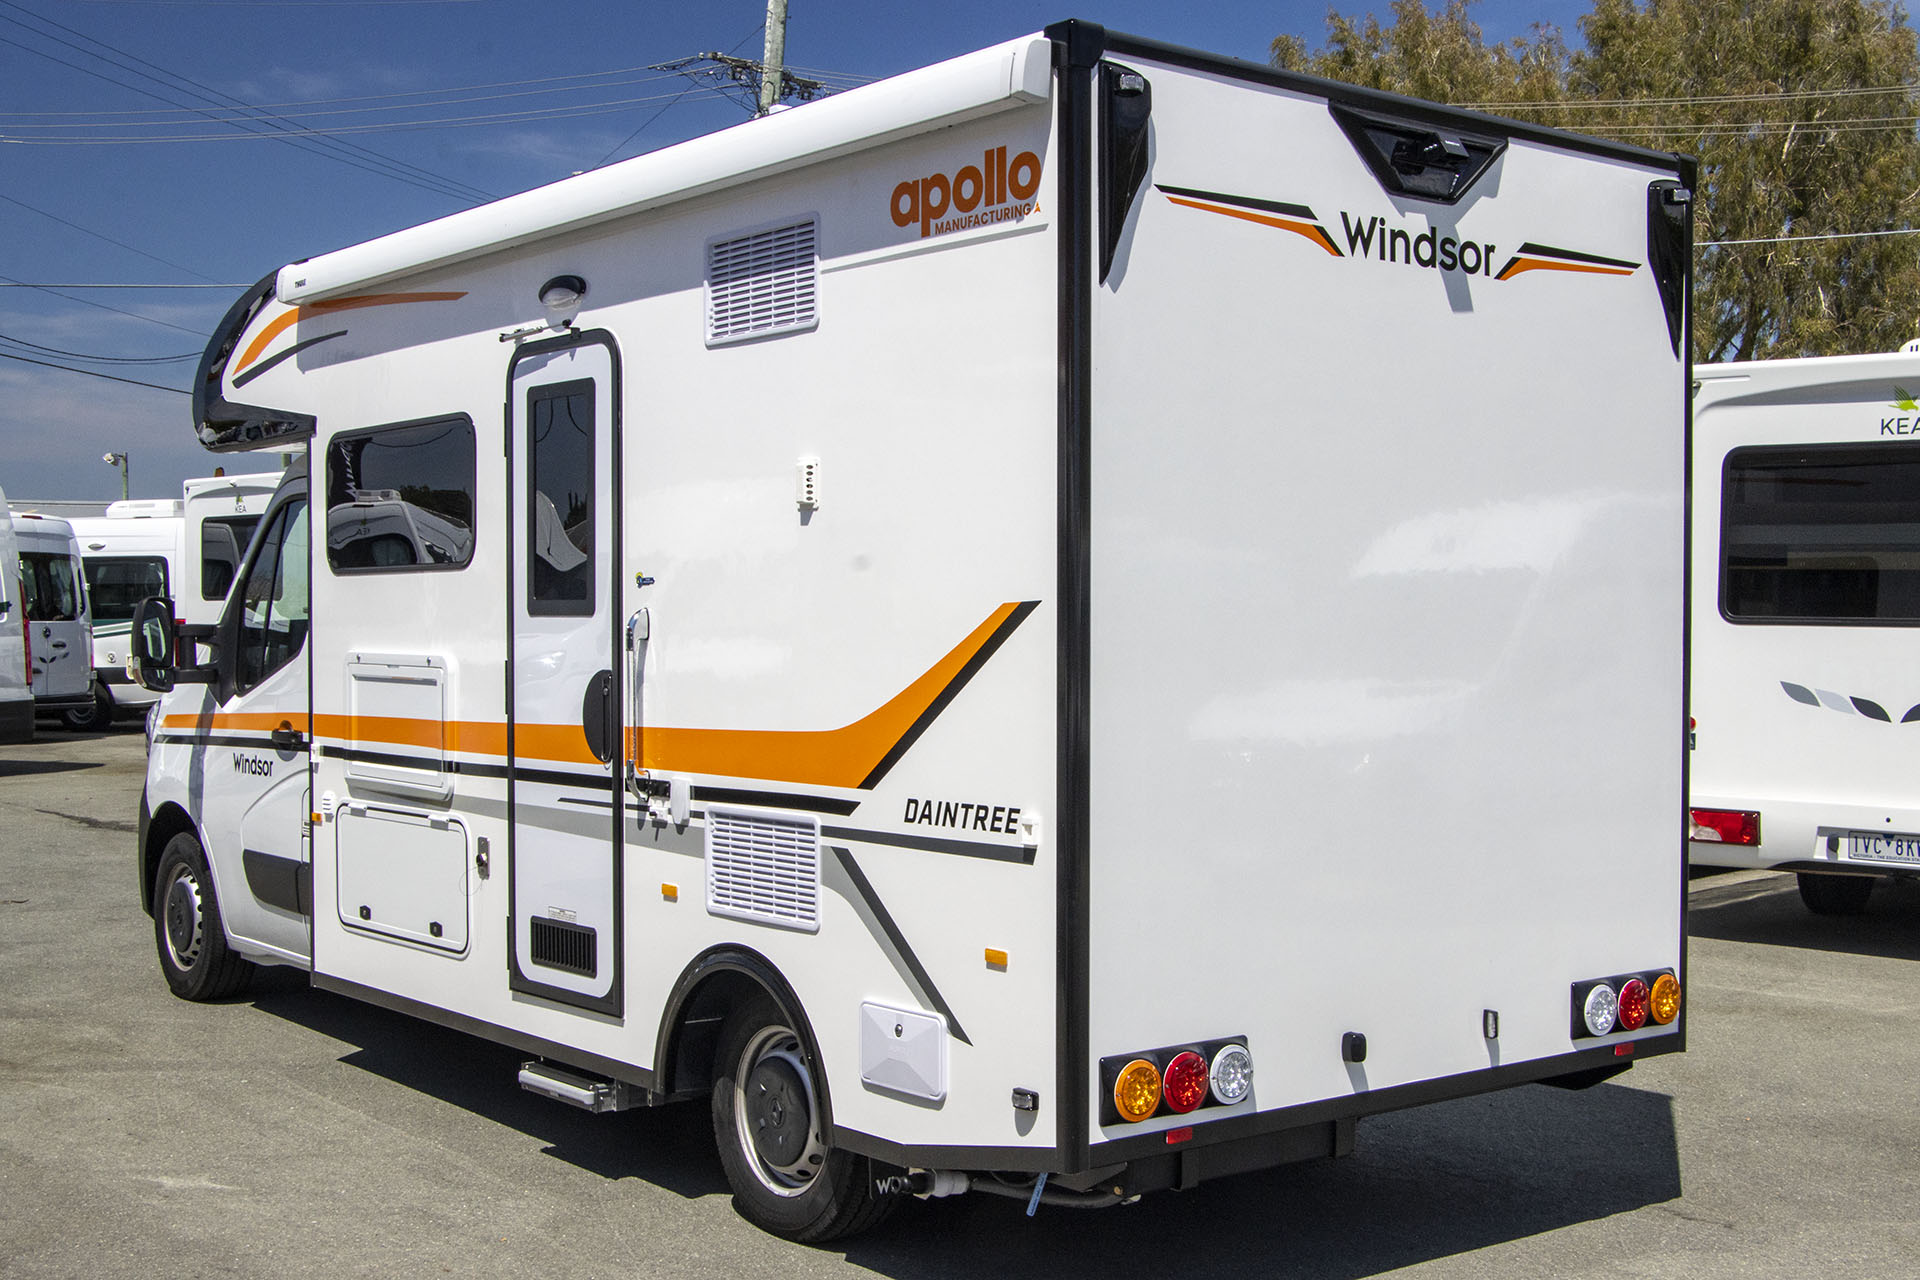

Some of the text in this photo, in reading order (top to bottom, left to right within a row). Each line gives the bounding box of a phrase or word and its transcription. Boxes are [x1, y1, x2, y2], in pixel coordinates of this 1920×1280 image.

[890, 145, 1042, 238] apollo
[934, 202, 1032, 236] MANUFACTURING
[1340, 211, 1496, 277] Windsor
[235, 505, 247, 513] KEA
[233, 752, 274, 777] Windsor
[904, 798, 1021, 835] DAINTREE
[1895, 838, 1920, 857] 8K
